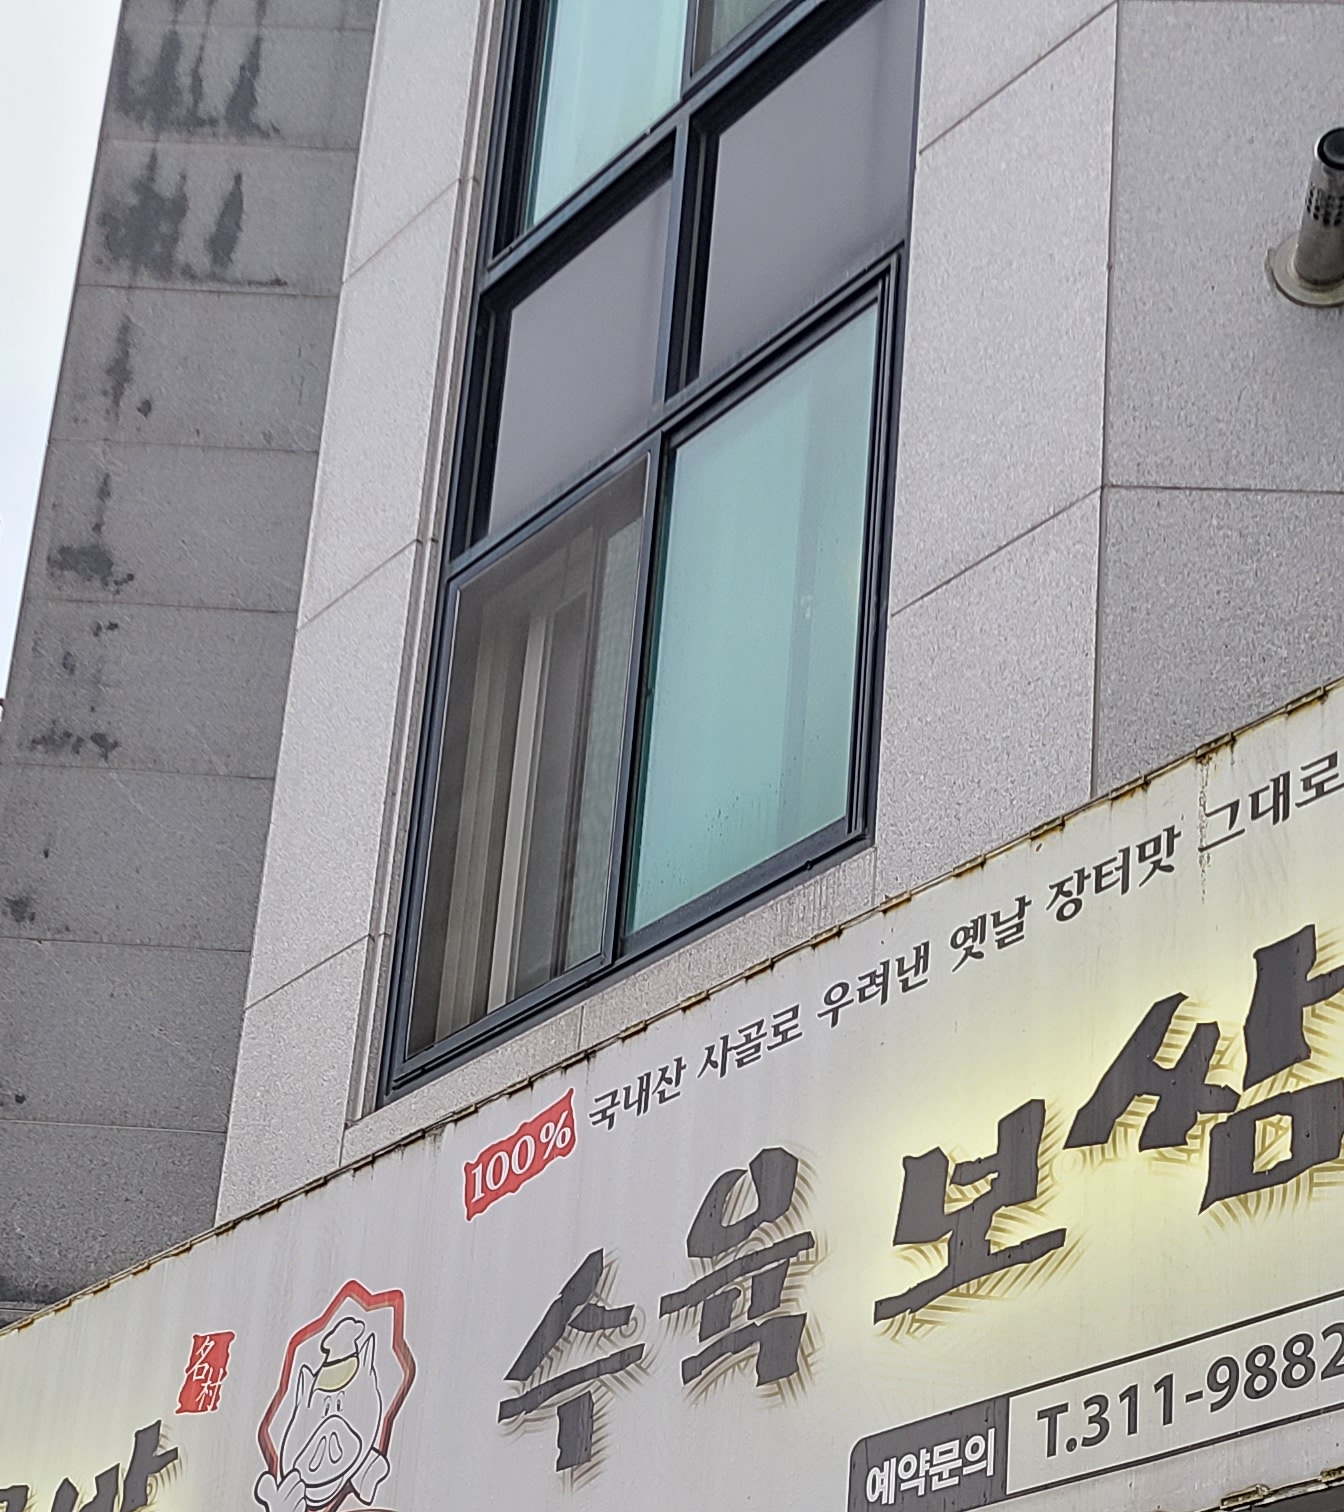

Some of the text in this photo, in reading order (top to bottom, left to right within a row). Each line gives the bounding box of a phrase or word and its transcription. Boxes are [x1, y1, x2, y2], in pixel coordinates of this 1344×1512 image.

[469, 1108, 573, 1201] 100%
[589, 1063, 686, 1132] 국내산
[698, 1002, 803, 1080] 사골로
[817, 940, 930, 1024] 우려낸
[949, 894, 1031, 973] 옛날
[1047, 825, 1182, 922] 장터맛
[864, 1426, 996, 1506] 예약문의
